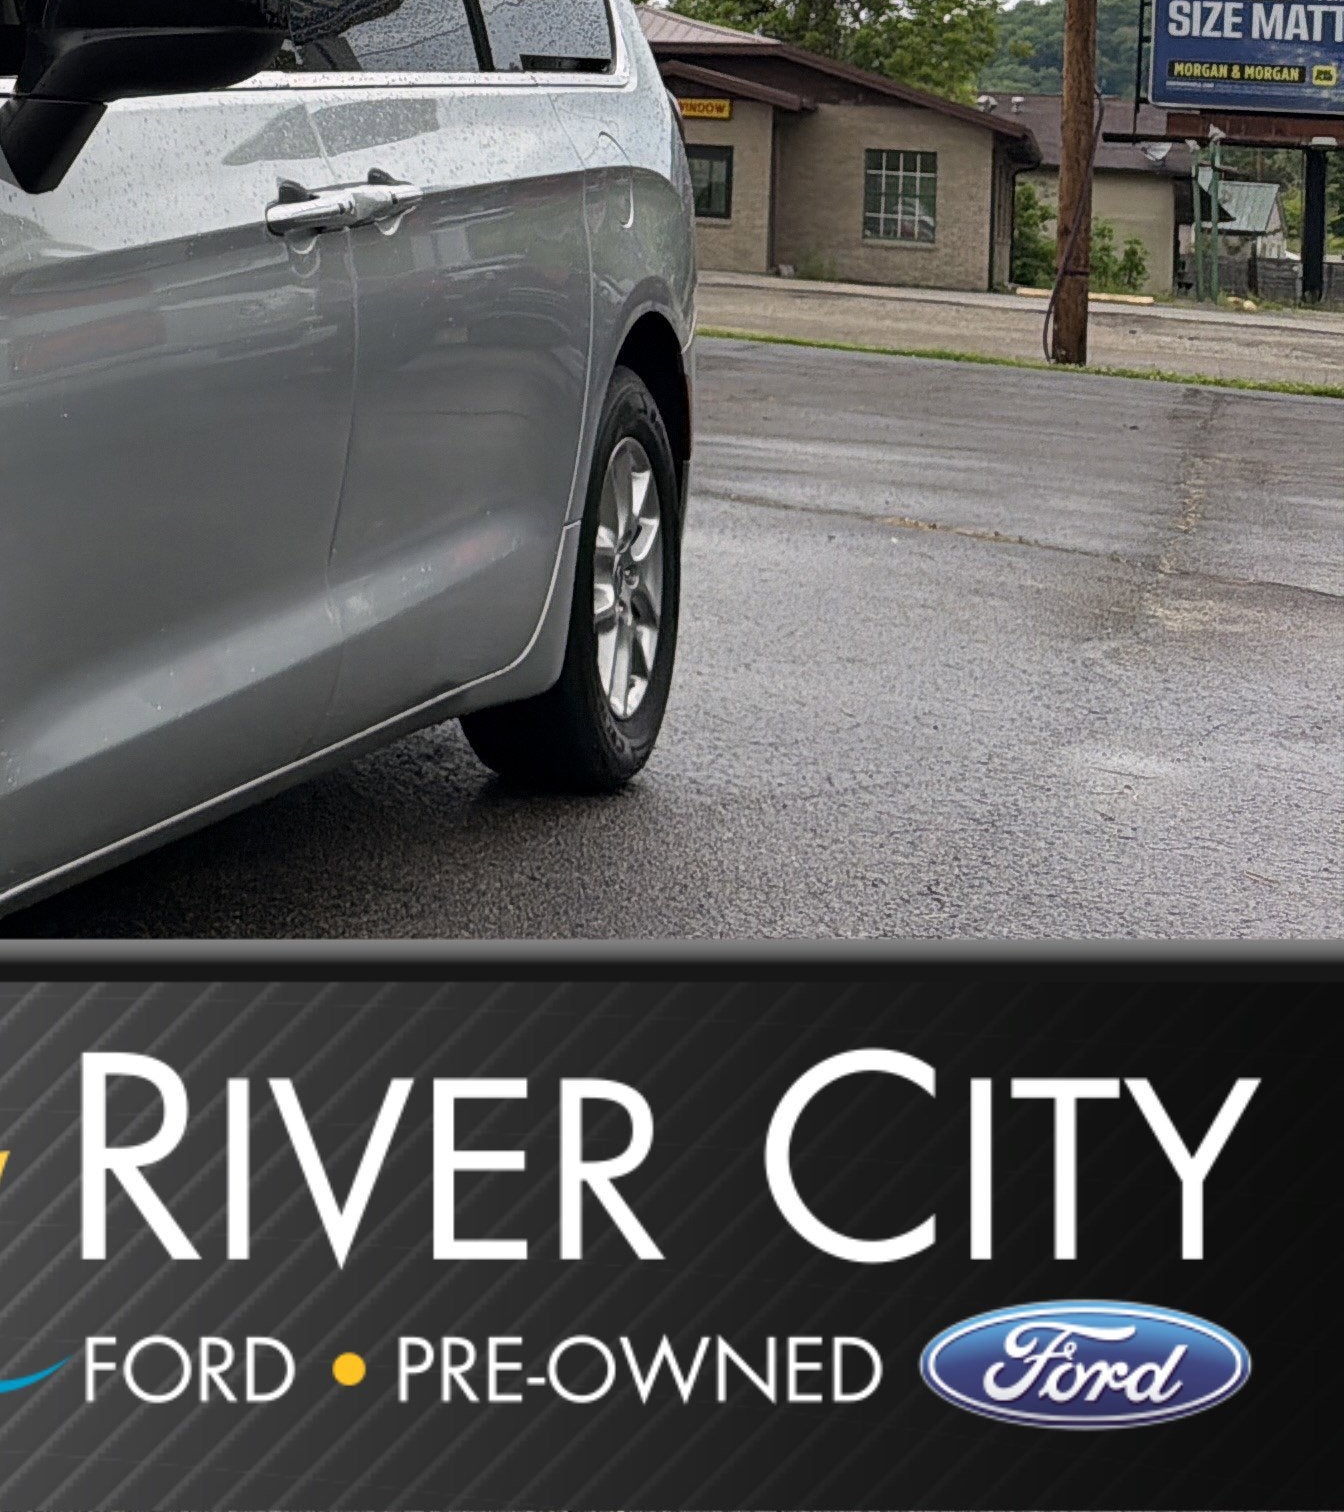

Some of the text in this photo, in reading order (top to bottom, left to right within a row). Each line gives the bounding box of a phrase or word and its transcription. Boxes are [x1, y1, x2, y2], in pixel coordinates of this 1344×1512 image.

[1168, 0, 1244, 38] SIZE
[1173, 62, 1300, 81] MORGAN & MORGAN
